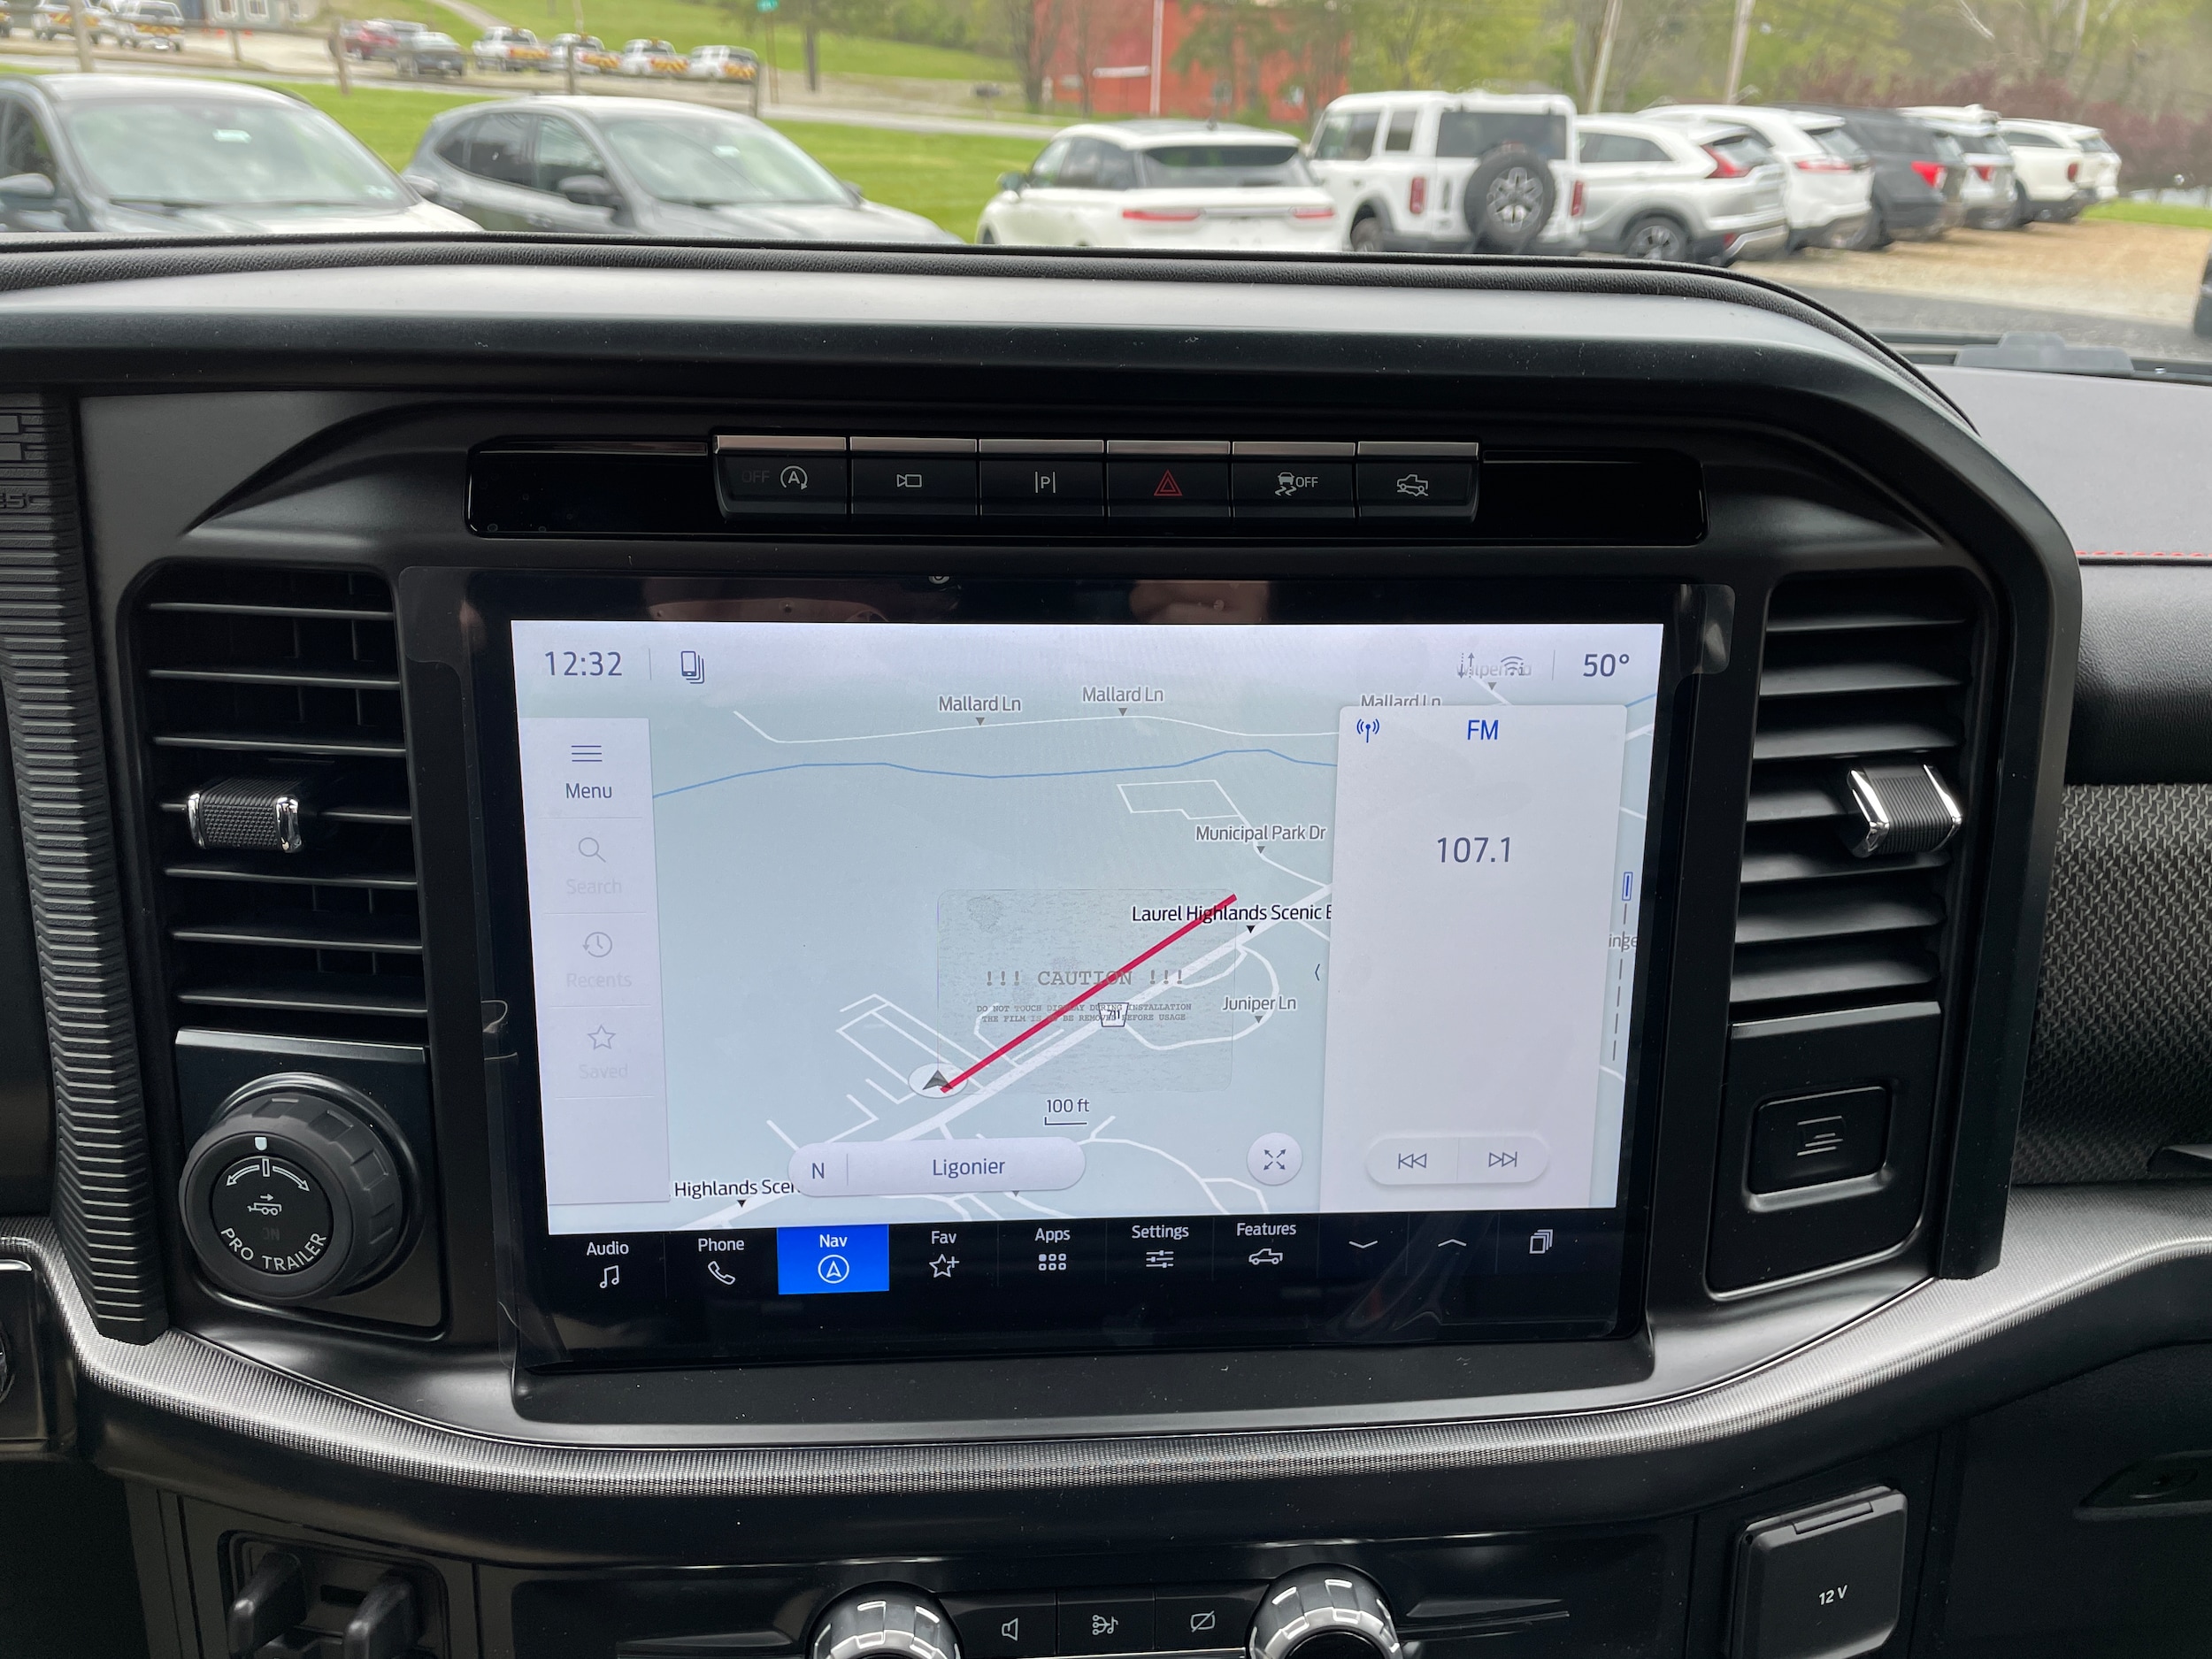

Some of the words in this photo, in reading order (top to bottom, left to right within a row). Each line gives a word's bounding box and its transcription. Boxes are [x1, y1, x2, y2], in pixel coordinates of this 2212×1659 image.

[741, 470, 770, 483] OFF
[1295, 476, 1318, 488] OFF
[545, 650, 622, 676] 12:32
[1582, 653, 1630, 677] 50°
[939, 695, 999, 711] Mallard
[1002, 695, 1022, 710] Ln
[1083, 687, 1141, 703] Mallard
[1145, 687, 1164, 702] Ln
[1361, 694, 1418, 706] Mallard
[1467, 719, 1499, 740] FM
[565, 783, 612, 800] Menu
[1196, 825, 1268, 843] Municipal
[1271, 825, 1305, 841] Park
[1309, 826, 1326, 840] Dr
[1437, 837, 1511, 863] 107.1
[566, 879, 622, 895] Search
[1133, 906, 1182, 921] Laurel
[1187, 904, 1267, 924] Highlands
[1271, 904, 1322, 920] Scenic
[566, 972, 633, 988] Recents
[1038, 970, 1133, 986] CAUTION
[1223, 996, 1273, 1013] Juniper
[1278, 996, 1297, 1010] Ln
[579, 1064, 628, 1079] Saved
[1046, 1100, 1073, 1114] 100
[1077, 1099, 1090, 1113] ft
[812, 1163, 825, 1179] N
[933, 1159, 1006, 1179] Ligonier
[674, 1179, 758, 1200] Highlands
[1034, 1227, 1071, 1243] Apps
[1131, 1225, 1189, 1240] Settings
[1237, 1222, 1297, 1237] Features
[698, 1238, 745, 1252] Phone
[819, 1234, 848, 1248] Nav
[931, 1231, 956, 1245] Fav
[220, 1227, 254, 1261] PRO
[262, 1233, 326, 1271] TRAILER
[586, 1240, 629, 1256] Audio
[1819, 1589, 1835, 1606] 12
[1838, 1584, 1848, 1600] V
